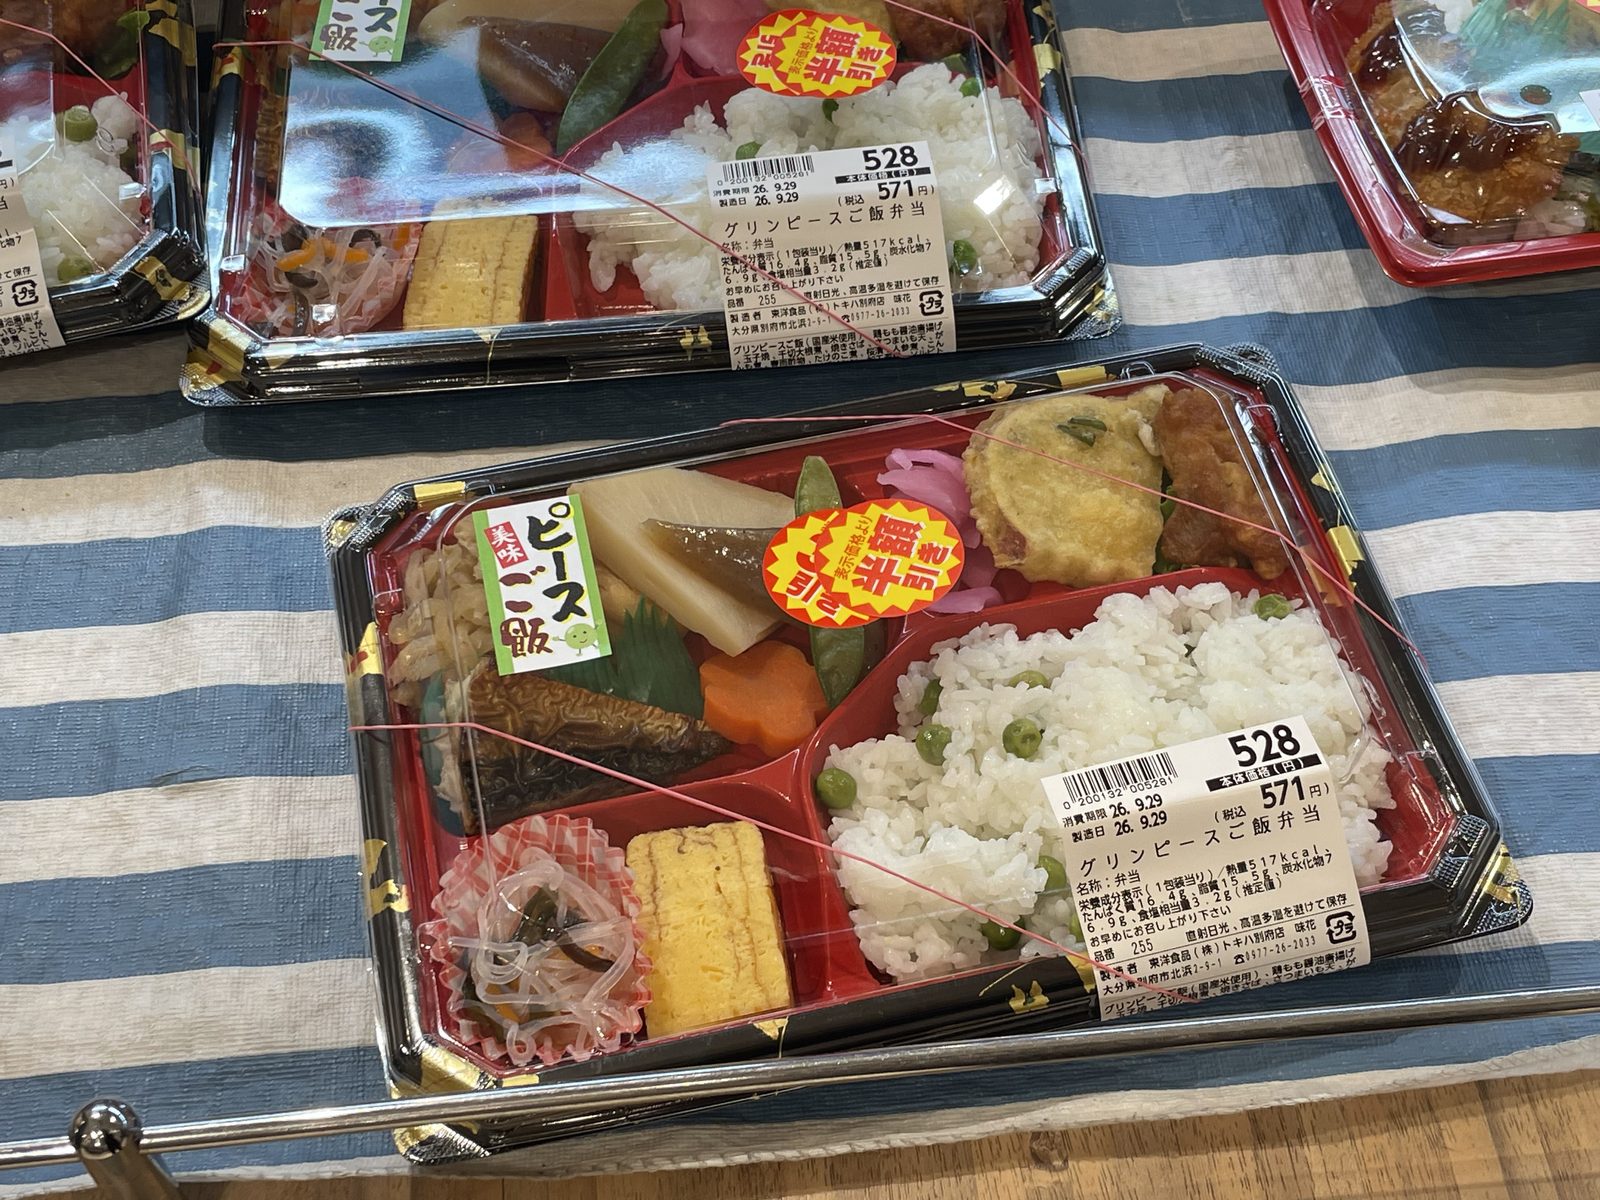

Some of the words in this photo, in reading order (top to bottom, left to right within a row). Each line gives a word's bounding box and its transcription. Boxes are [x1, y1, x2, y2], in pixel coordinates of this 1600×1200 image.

[363, 0, 398, 32] ス
[803, 26, 861, 85] 半額
[846, 46, 884, 81] 引き
[863, 144, 918, 171] 528
[719, 196, 746, 207] 製造日
[776, 191, 799, 203] 9.29
[724, 201, 924, 237] グリンピースご飯弁当
[19, 286, 36, 300] プラ
[727, 297, 744, 308] 品番
[758, 294, 776, 305] 255
[491, 526, 524, 563] 美味
[526, 502, 586, 622] ピース
[834, 515, 873, 580] 表示価格より
[852, 513, 927, 597] 半額
[902, 541, 953, 591] 引き
[499, 565, 553, 658] ご飯
[1228, 721, 1301, 768] 528
[1218, 758, 1304, 786] 本体価格(円)
[1061, 807, 1107, 827] 消費期限
[1134, 792, 1163, 811] 9.29
[1063, 801, 1071, 810] 0
[1077, 788, 1122, 806] 200132
[1129, 775, 1172, 793] 005281
[1071, 825, 1105, 842] 製造日
[1138, 809, 1168, 829] 9.29
[1078, 804, 1320, 877] グリンピースご飯弁当
[1075, 869, 1140, 896] 名称:弁当
[1089, 904, 1231, 948] お早めにお召し上がり下さい
[1093, 947, 1115, 963] 品番
[1130, 938, 1154, 954] 255
[1185, 892, 1347, 942] 直射日光、高温多湿を避けて保存
[1294, 919, 1316, 933] 味花
[1332, 917, 1354, 936] プラ
